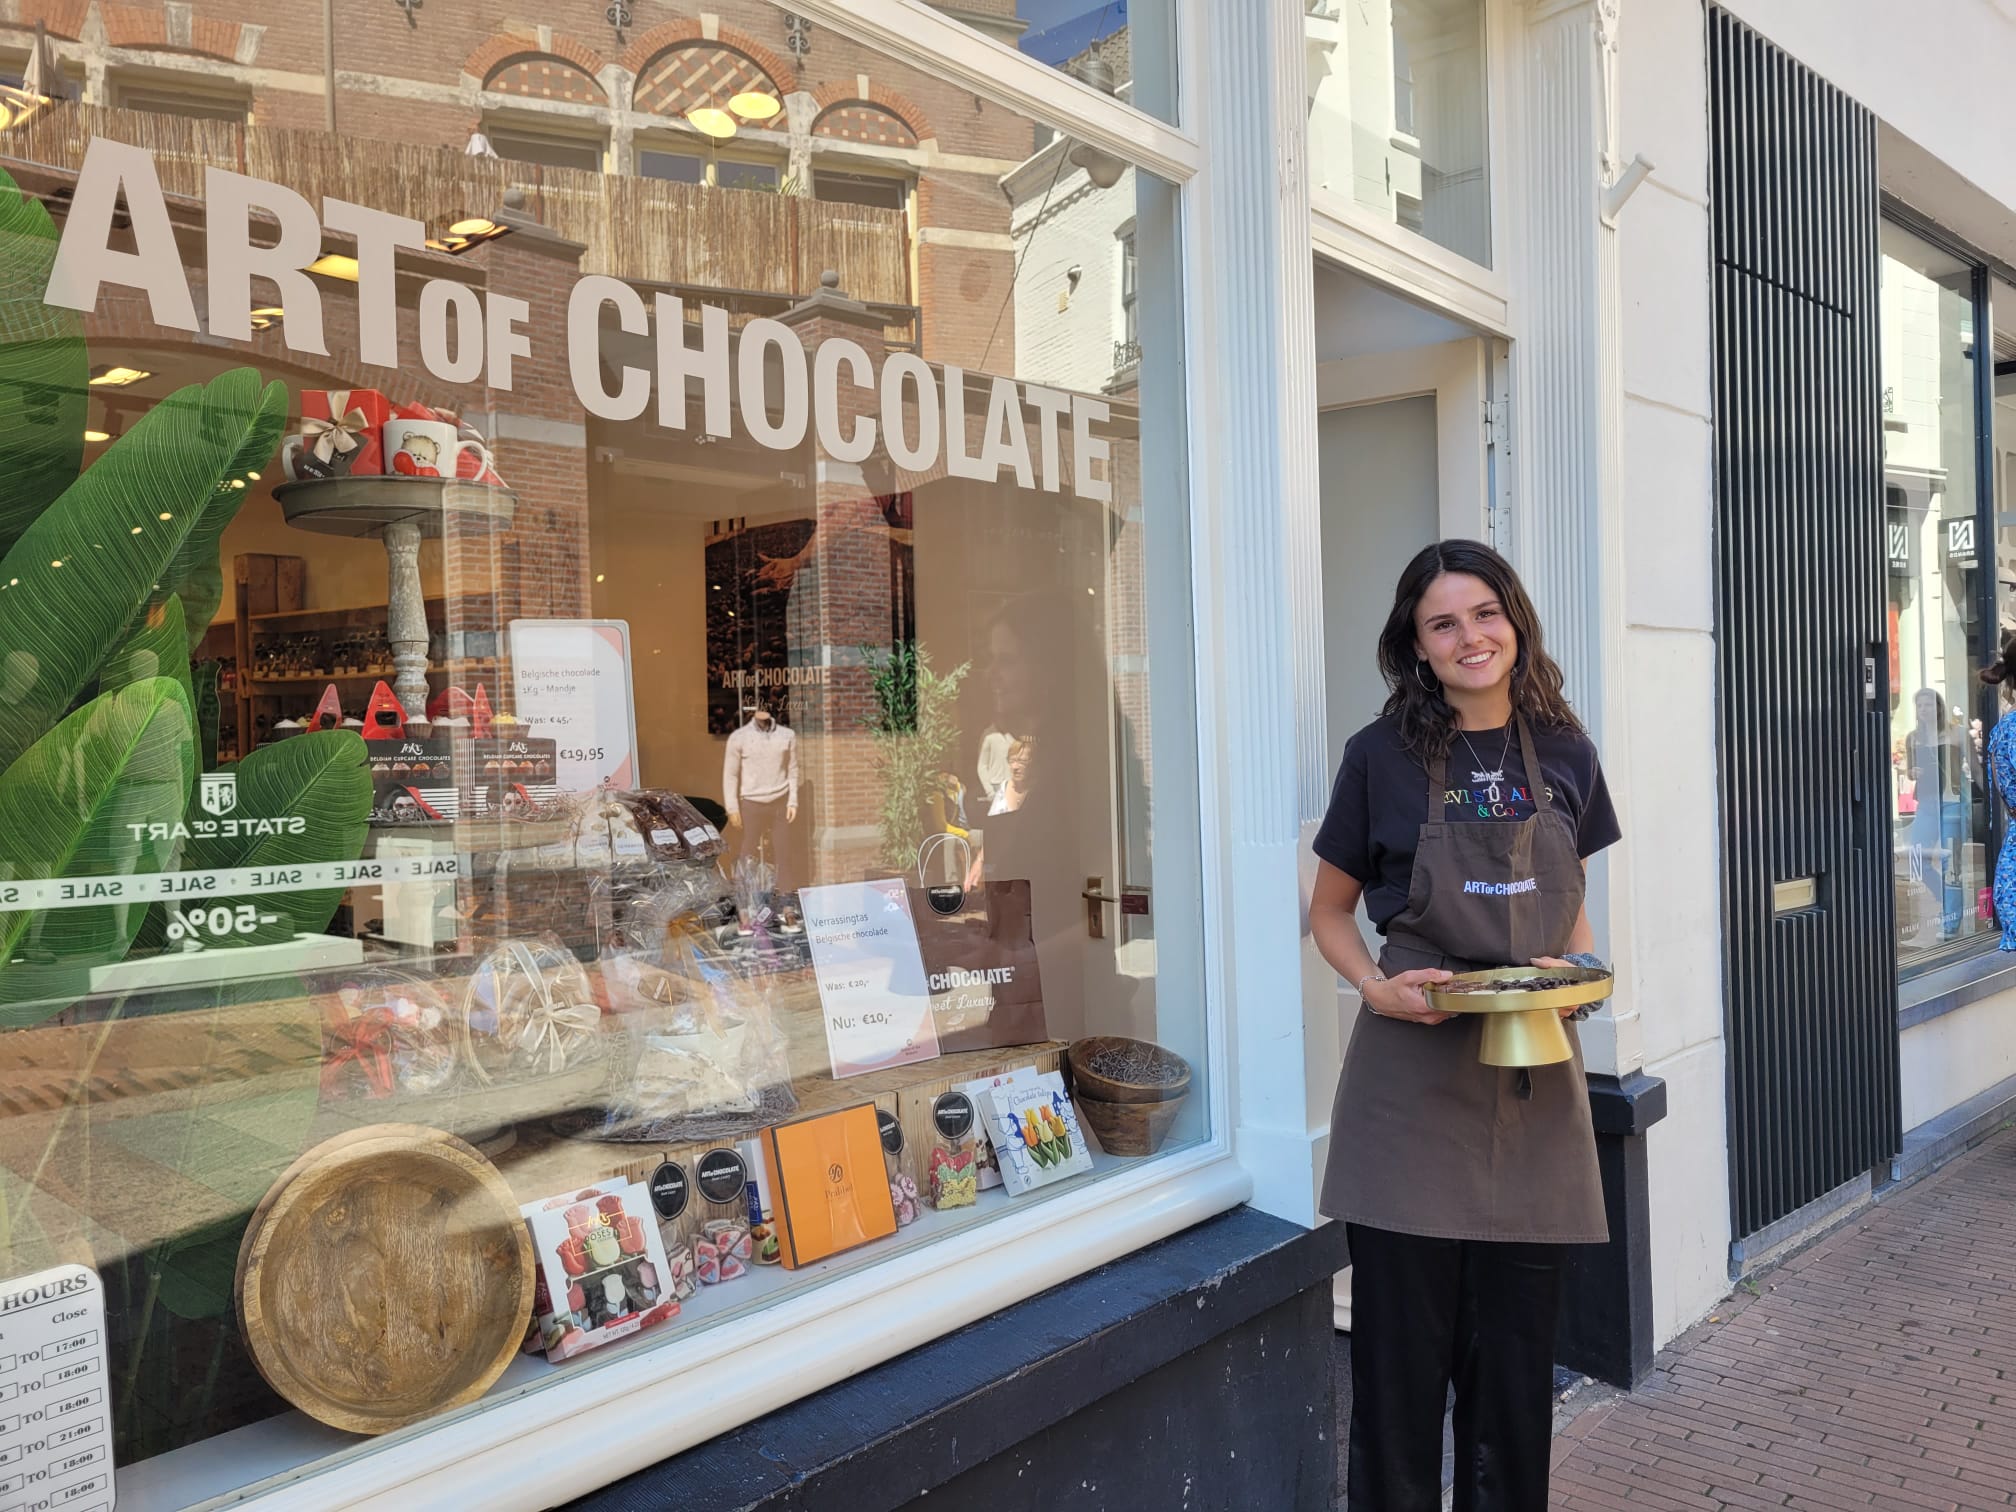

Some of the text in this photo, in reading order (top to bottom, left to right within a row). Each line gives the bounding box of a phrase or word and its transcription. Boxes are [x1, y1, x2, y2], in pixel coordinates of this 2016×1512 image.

[43, 135, 1113, 502] ART OF CHOCOLATE
[521, 667, 600, 680] Belgische chocolade
[722, 669, 747, 688] ART
[755, 665, 831, 687] CHOCOLATE
[545, 684, 576, 694] Mandje
[560, 747, 604, 761] €19,95
[1443, 788, 1472, 805] EVI
[1463, 880, 1488, 894] ART
[1495, 877, 1537, 895] CHOCOLATE
[812, 913, 869, 927] Verrassingtas
[815, 927, 889, 944] Belgische chocolade
[825, 982, 846, 991] Was:
[931, 994, 996, 1011] eet Luxury
[832, 1012, 893, 1031] Nu: €10,-
[1, 1273, 88, 1312] HOURS
[52, 1308, 88, 1324] Close
[19, 1337, 86, 1364] TO 17:00
[20, 1364, 88, 1394] TO 18:00
[22, 1396, 90, 1424] TO 18:00
[24, 1424, 91, 1454] TO 21:00
[26, 1453, 93, 1484] TO 18:00
[28, 1482, 95, 1512] TO 18:00
